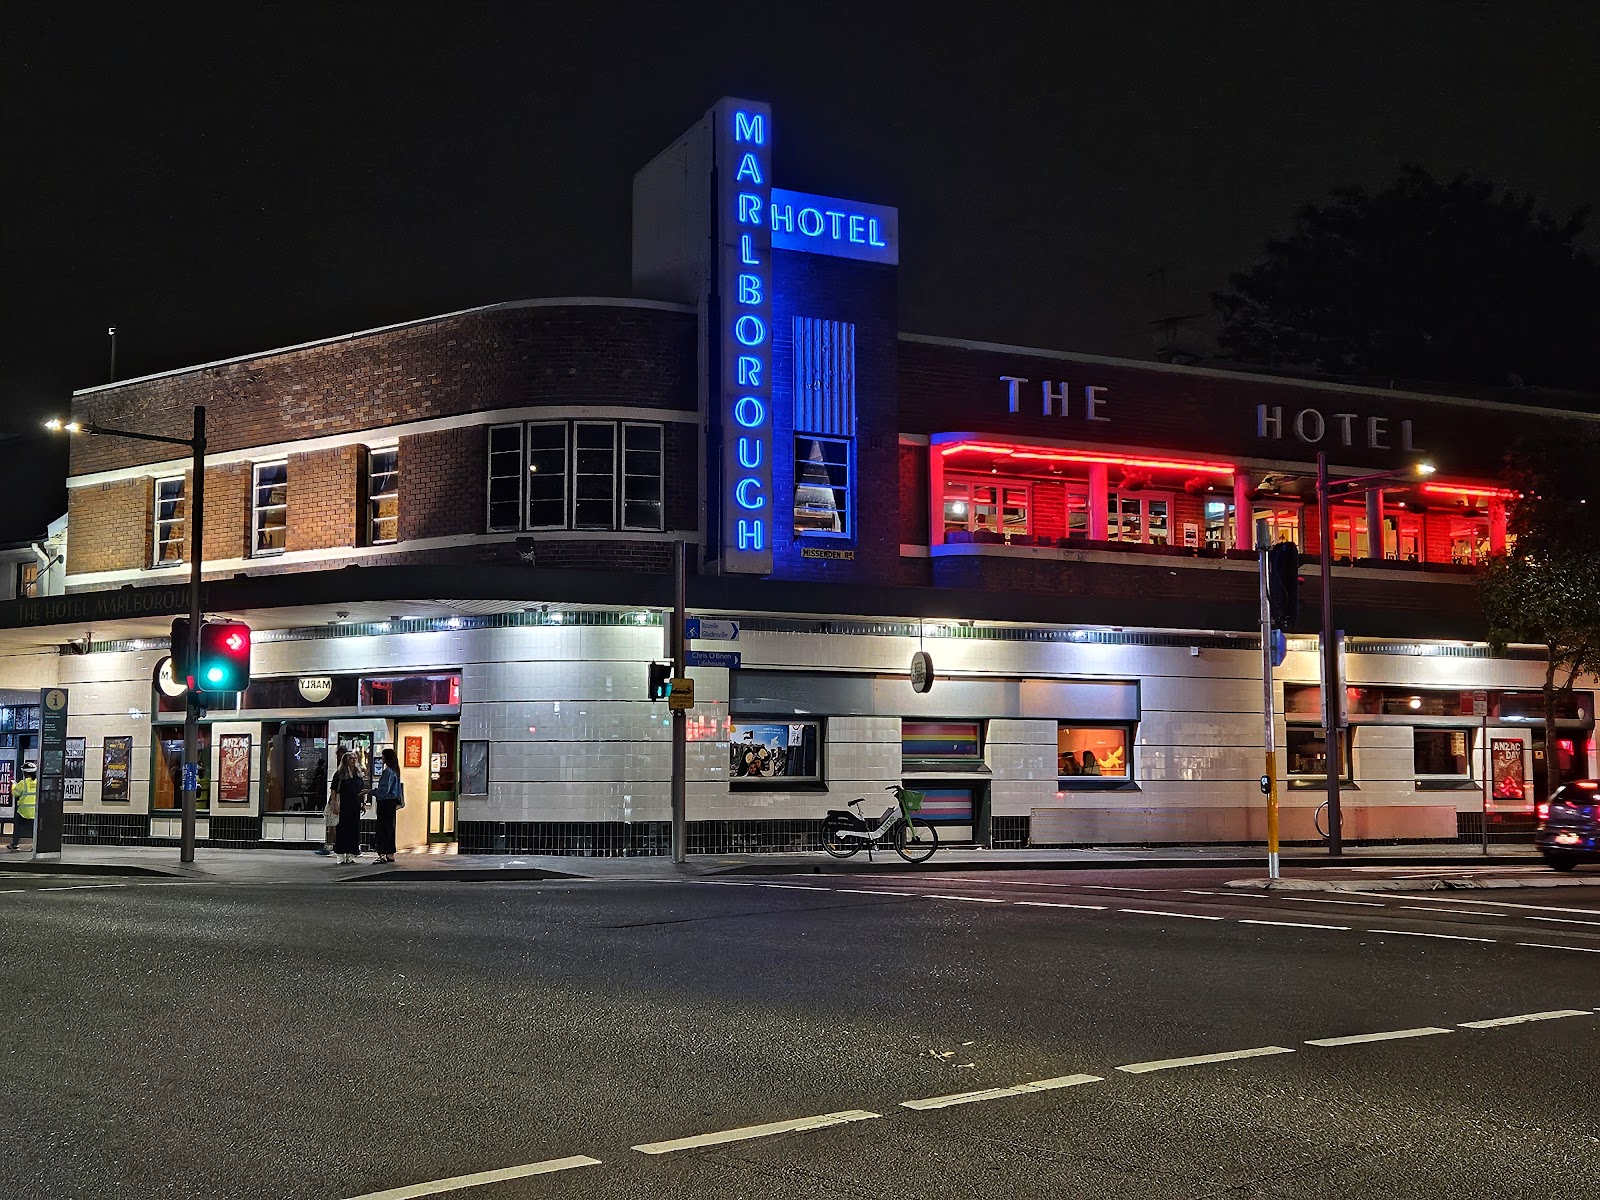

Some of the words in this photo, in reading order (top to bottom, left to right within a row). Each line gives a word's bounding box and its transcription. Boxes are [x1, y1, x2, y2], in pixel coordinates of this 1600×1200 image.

[771, 203, 886, 250] HOTEL
[736, 112, 766, 550] MARLBOROUGH
[999, 375, 1111, 422] THE
[1257, 403, 1426, 452] HOTEL
[18, 603, 40, 621] THE
[46, 599, 88, 619] HOTEL
[222, 738, 249, 748] ANZAC
[1493, 742, 1521, 752] ANZAC
[234, 748, 248, 757] DAY
[1506, 751, 1521, 760] DAY
[65, 784, 82, 795] ARLY
